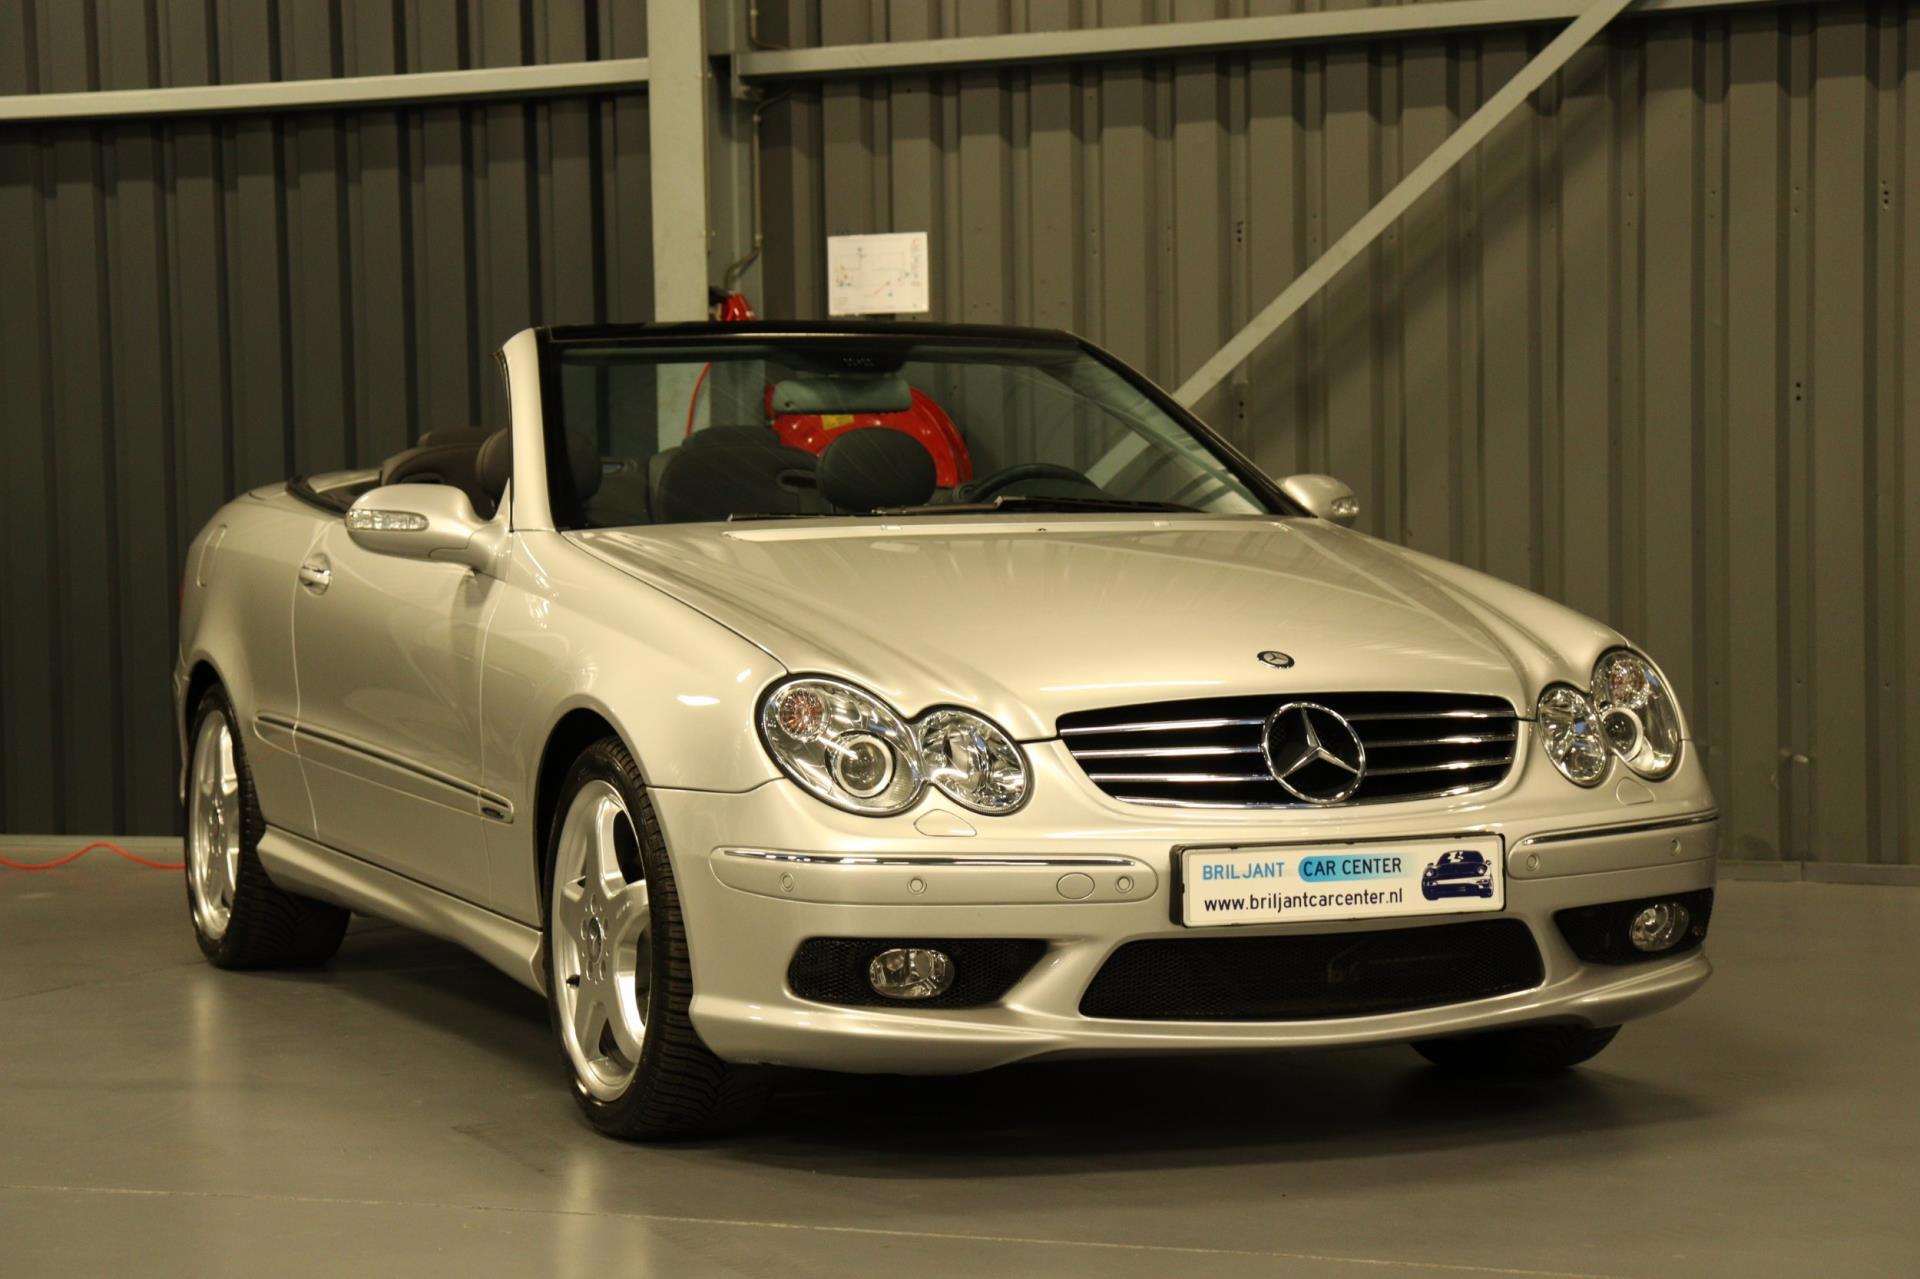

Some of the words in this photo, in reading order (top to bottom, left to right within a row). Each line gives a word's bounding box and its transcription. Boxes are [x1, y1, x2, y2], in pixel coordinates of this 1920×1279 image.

[1202, 862, 1285, 880] BRILJANT
[1303, 859, 1337, 876] CAR
[1342, 857, 1402, 875] CENTER
[1204, 888, 1403, 912] www.briljantcarcenter.nl
